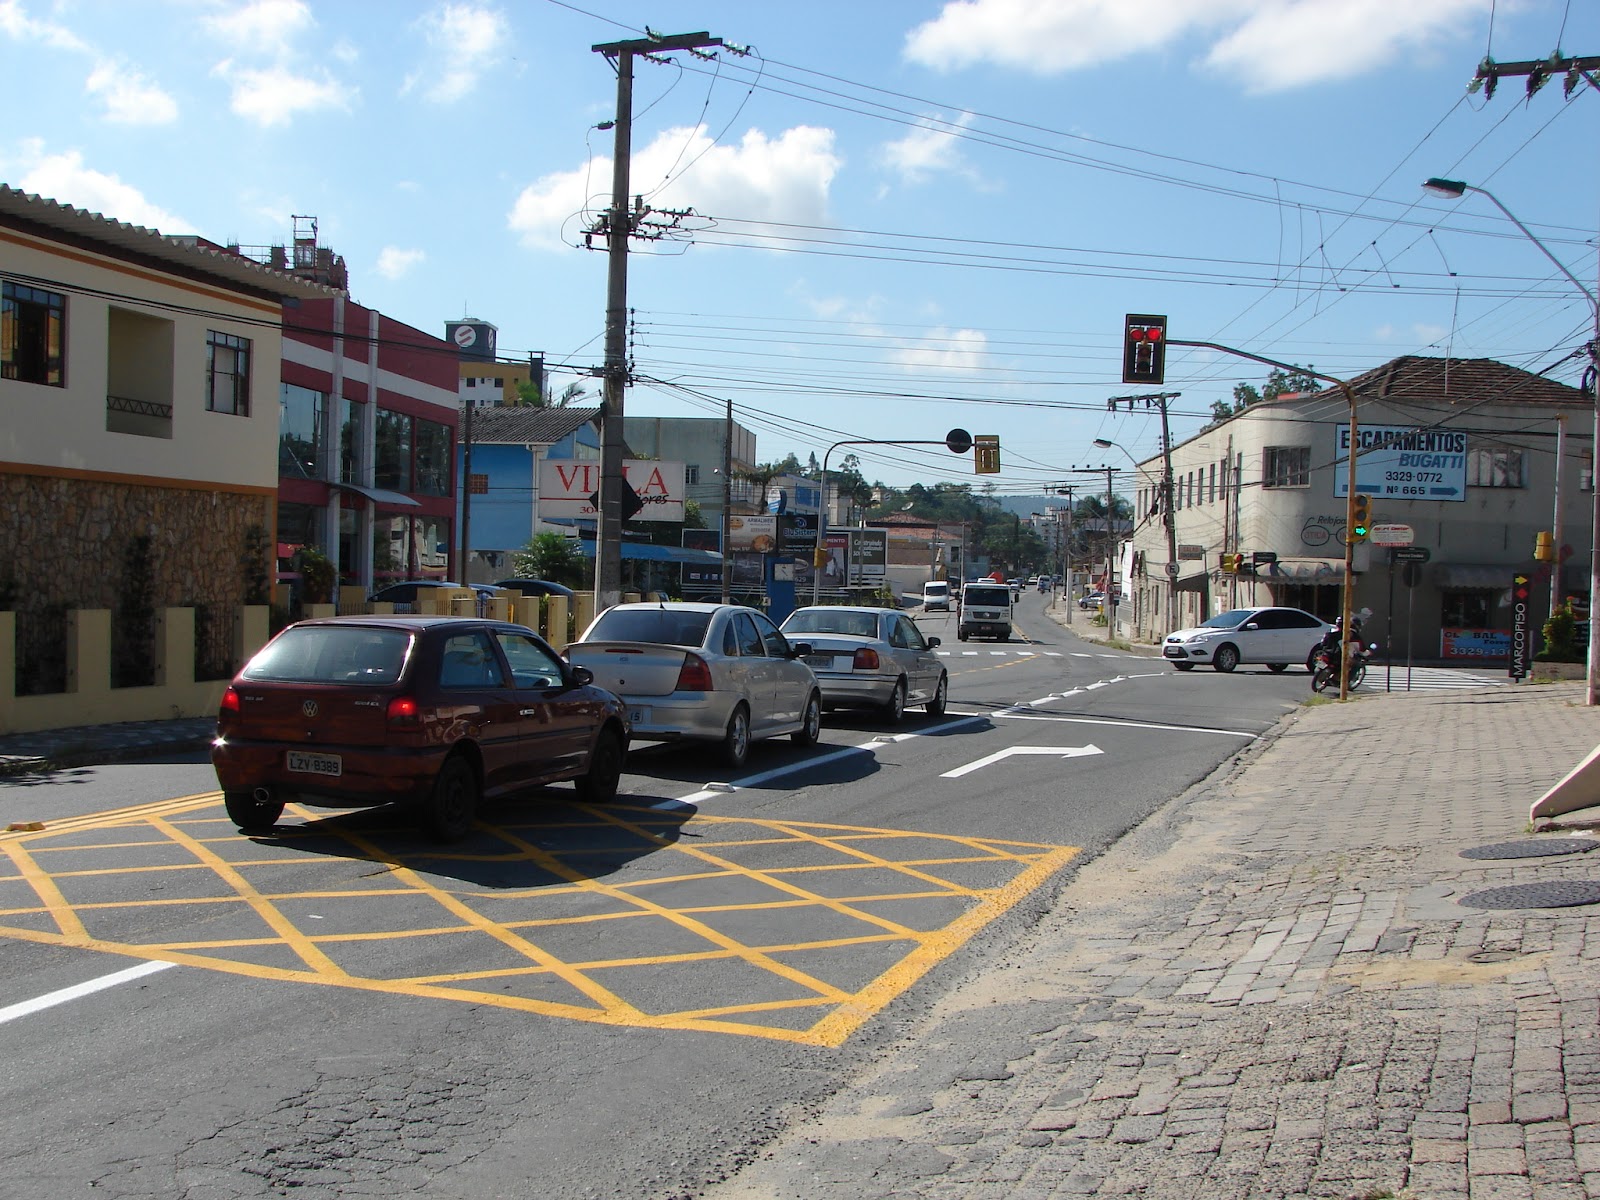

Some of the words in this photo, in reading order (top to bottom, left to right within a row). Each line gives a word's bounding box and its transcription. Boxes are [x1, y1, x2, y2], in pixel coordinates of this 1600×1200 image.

[1398, 453, 1464, 468] BUGATTI
[1385, 471, 1443, 482] 3329-0772
[1403, 486, 1426, 495] 665
[1514, 603, 1526, 676] MARCOPISO
